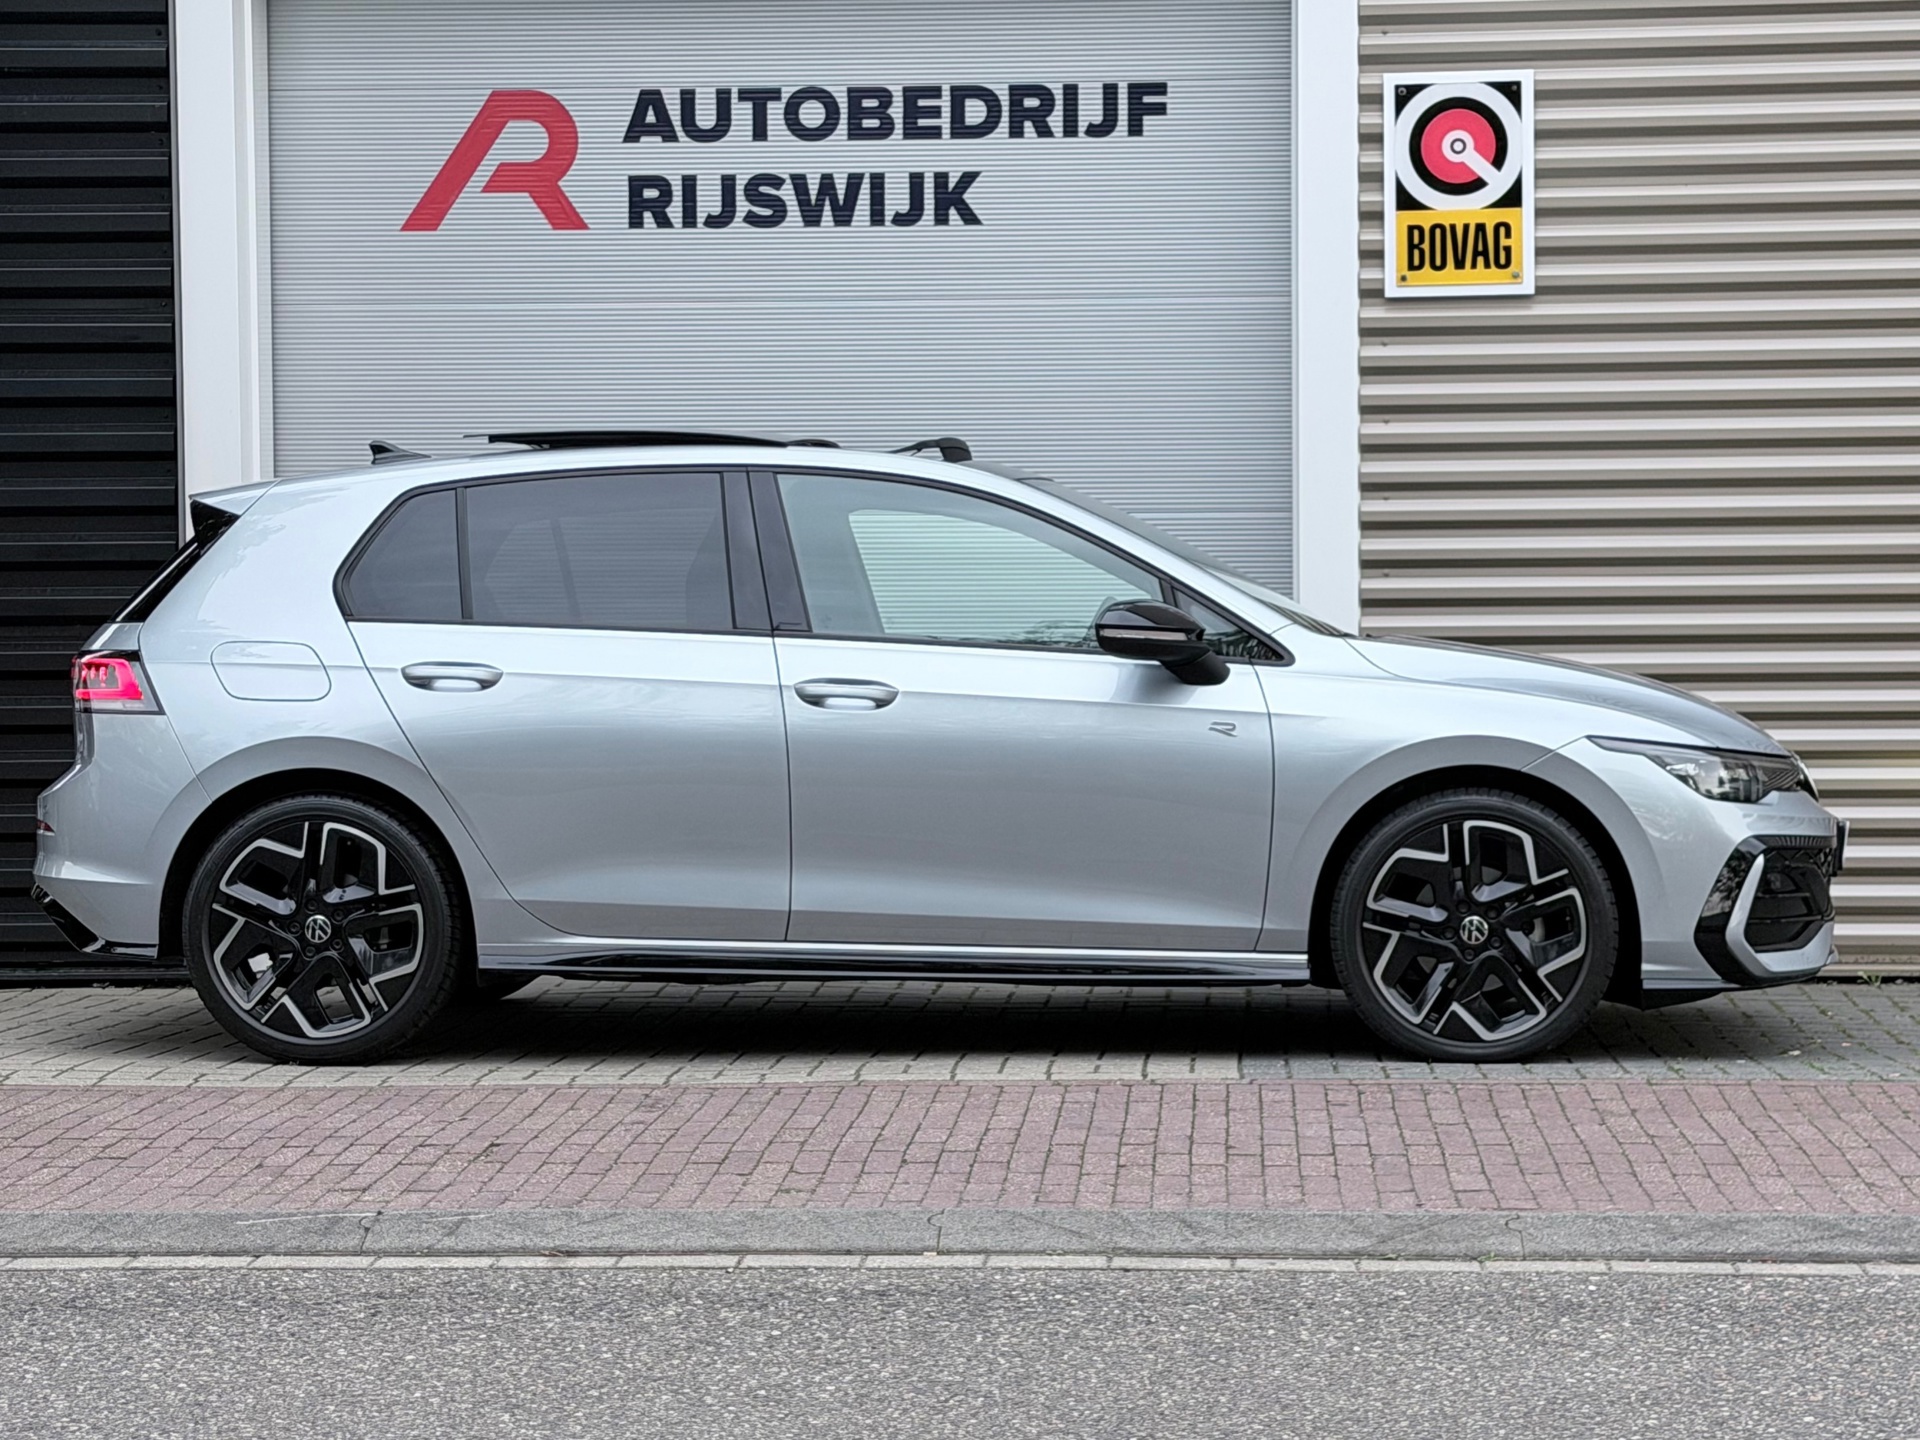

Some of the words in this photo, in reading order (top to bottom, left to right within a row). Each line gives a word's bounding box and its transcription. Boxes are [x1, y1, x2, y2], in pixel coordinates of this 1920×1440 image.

[622, 82, 1168, 143] AUTOBEDRIJF
[627, 171, 983, 229] RIJSWIJK
[1407, 221, 1512, 271] BOVAG
